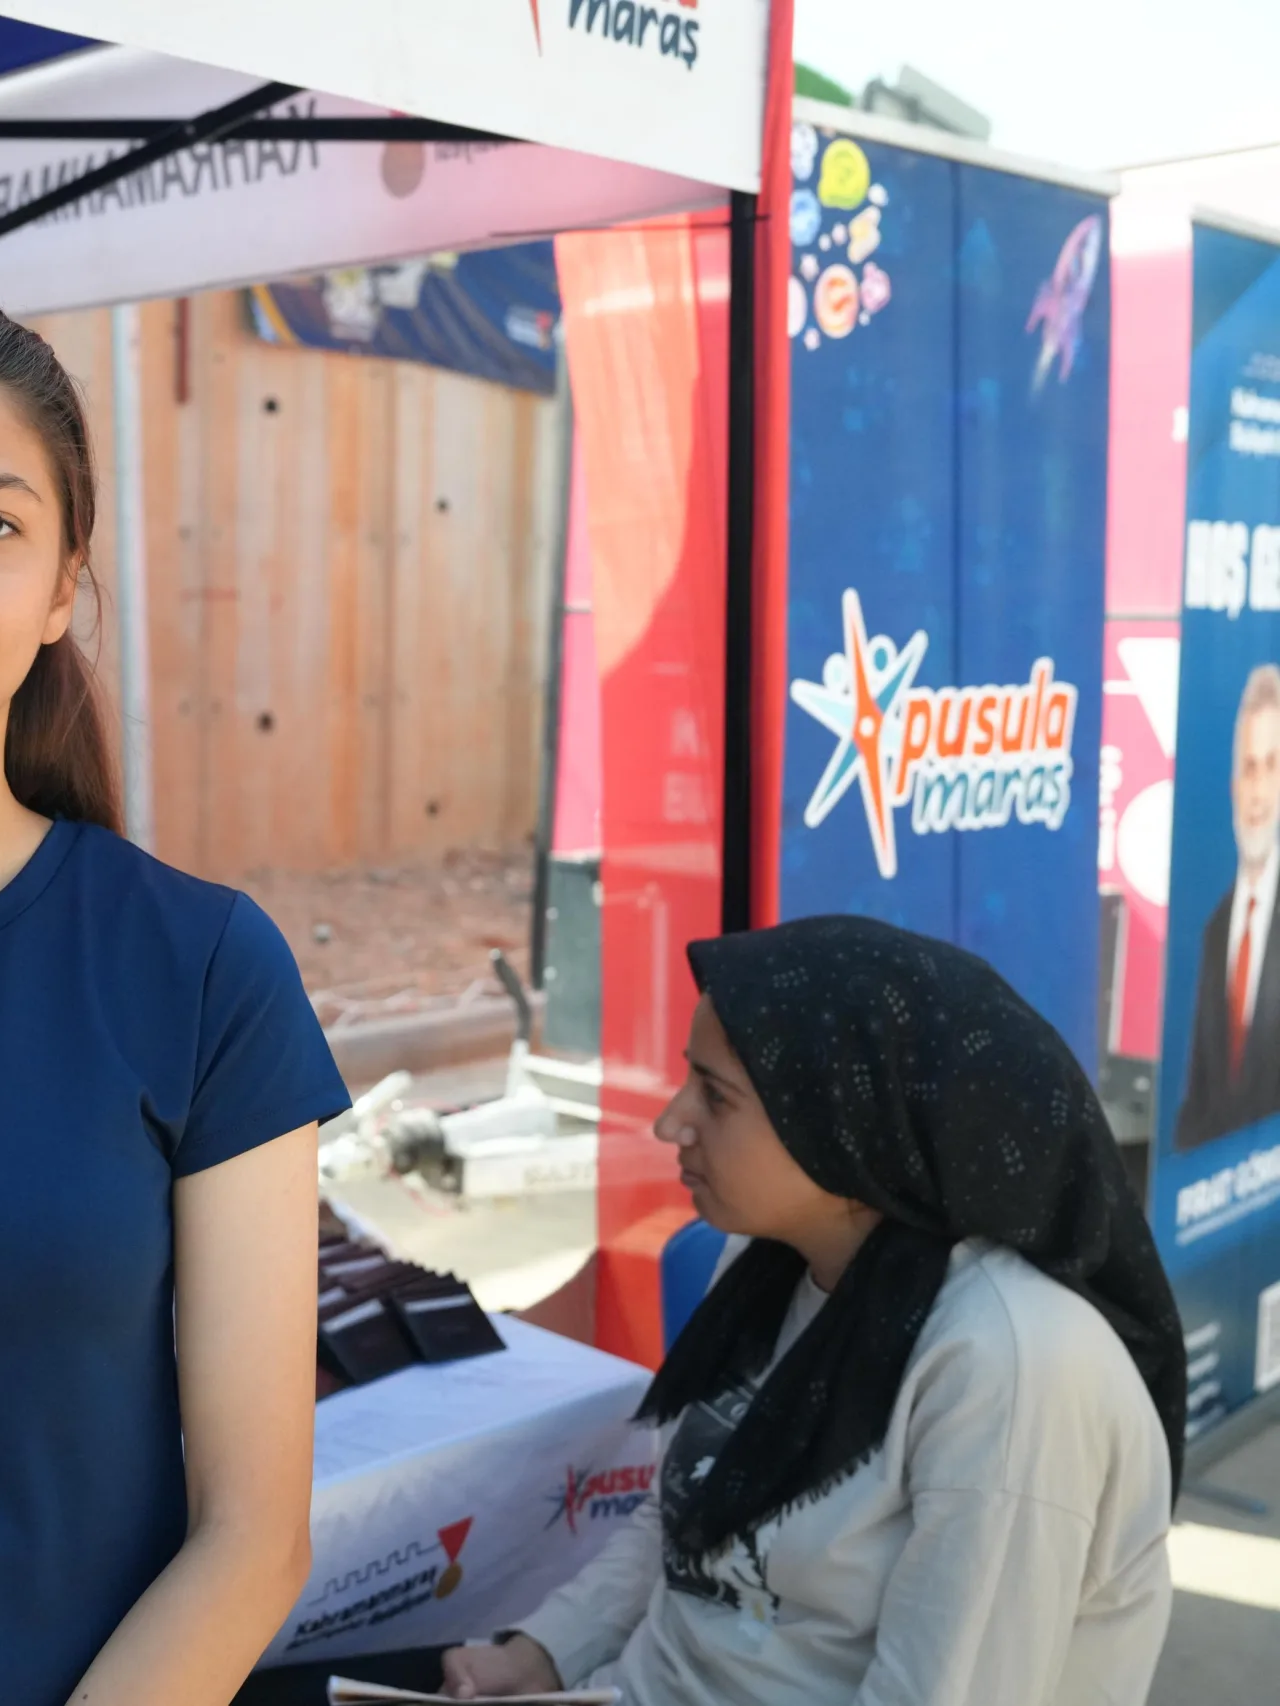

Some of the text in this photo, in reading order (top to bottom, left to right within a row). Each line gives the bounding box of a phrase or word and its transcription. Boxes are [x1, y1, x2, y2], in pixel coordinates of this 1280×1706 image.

[568, 0, 699, 71] maraş
[896, 667, 1070, 796] pusula
[917, 758, 1068, 829] maraş
